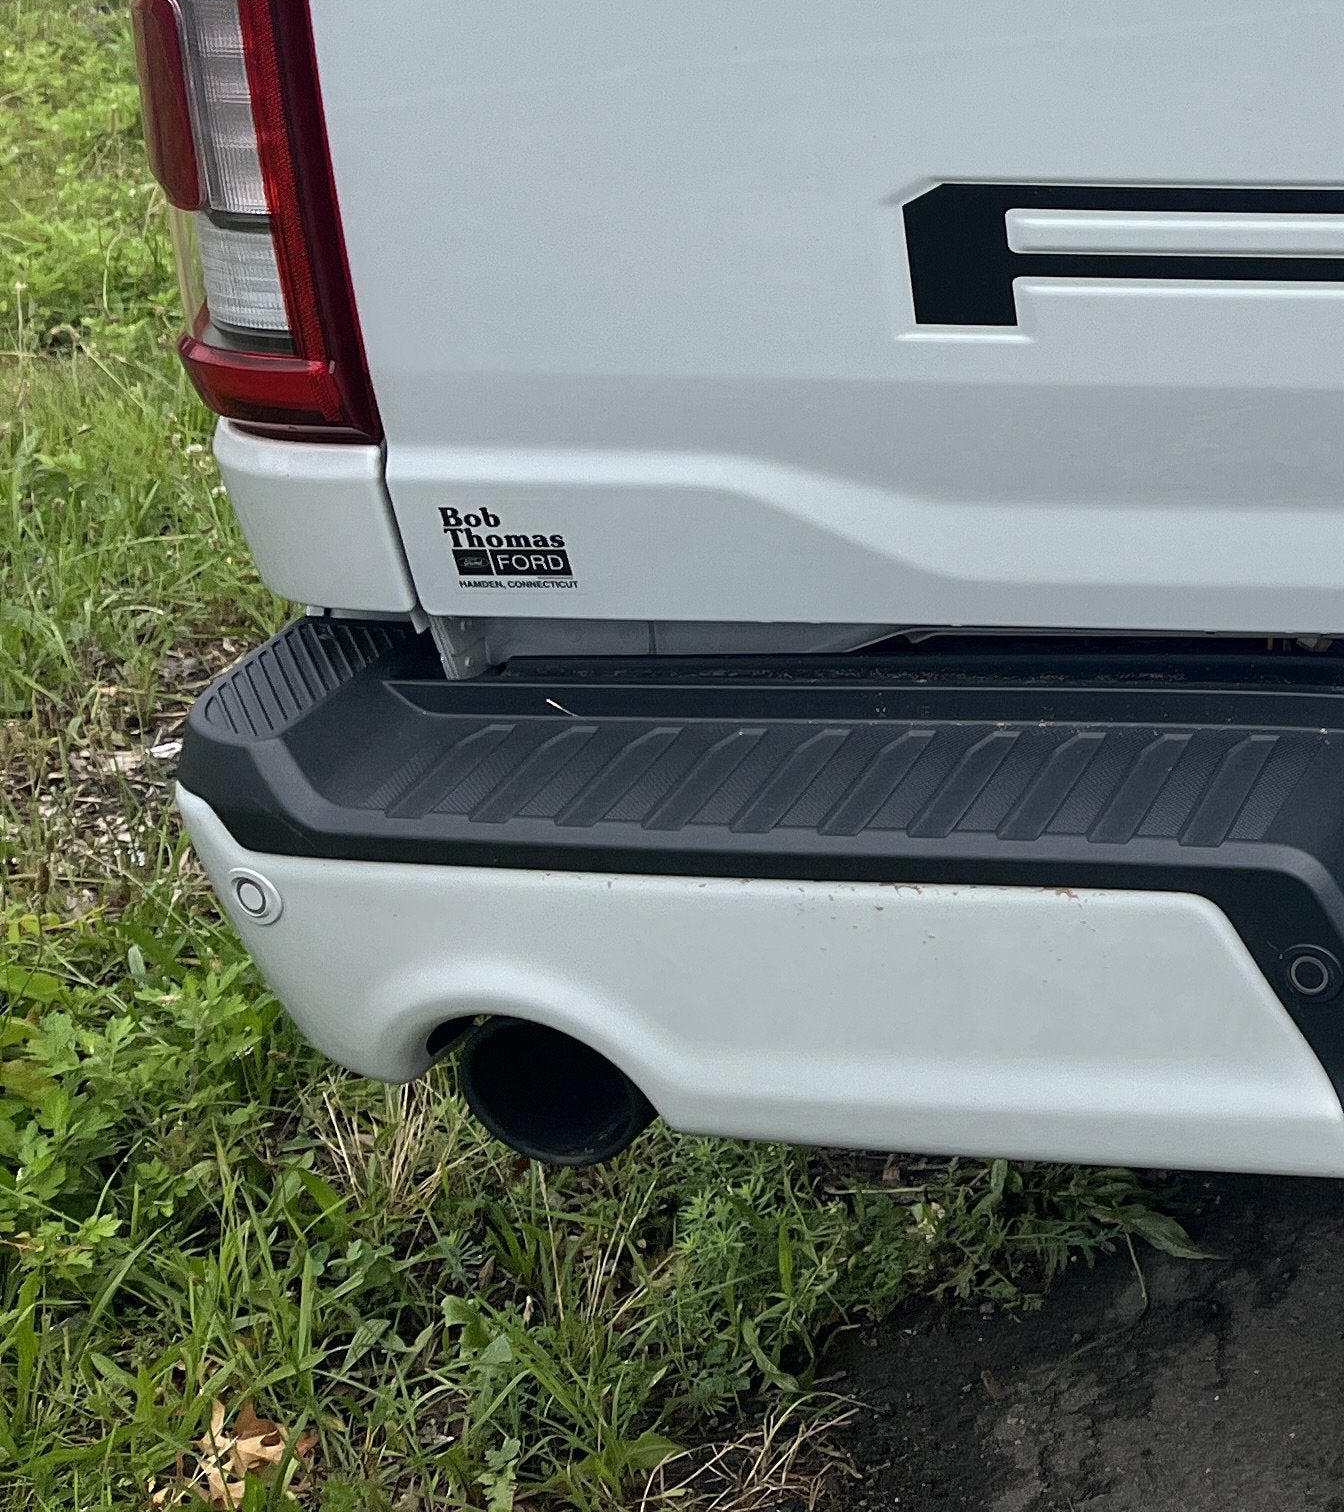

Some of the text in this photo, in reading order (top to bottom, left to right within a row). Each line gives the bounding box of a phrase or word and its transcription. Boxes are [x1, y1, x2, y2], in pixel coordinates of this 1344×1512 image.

[438, 507, 501, 529] Bob
[443, 527, 566, 548] Thomas
[496, 554, 564, 571] FORD
[458, 579, 579, 590] HAMDEN, CONNECTICUT
